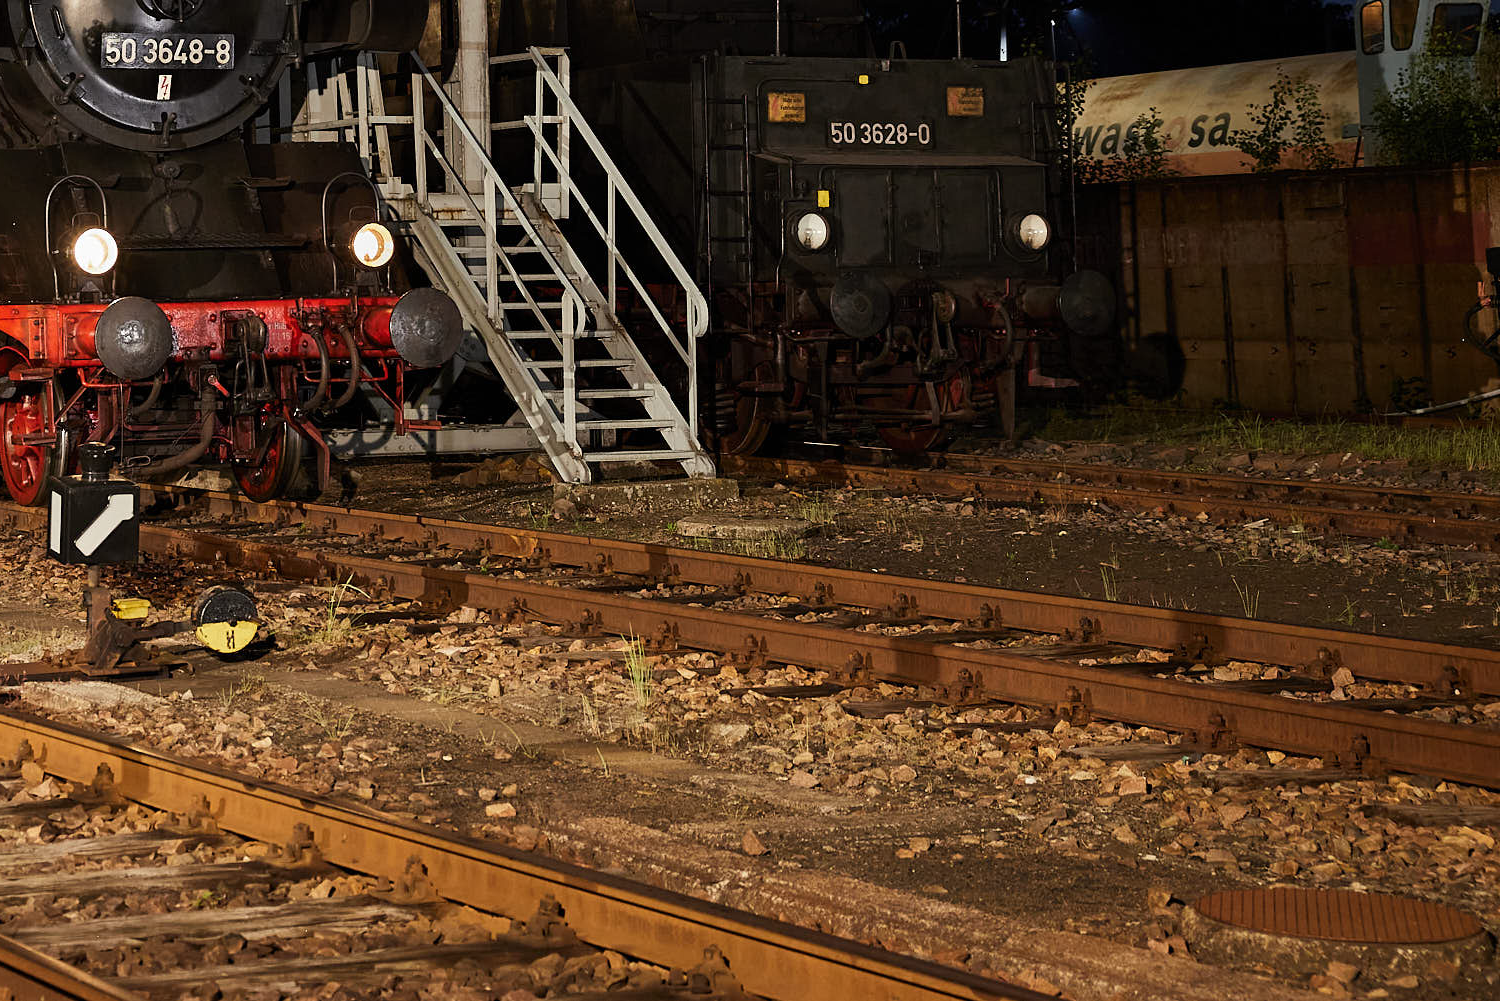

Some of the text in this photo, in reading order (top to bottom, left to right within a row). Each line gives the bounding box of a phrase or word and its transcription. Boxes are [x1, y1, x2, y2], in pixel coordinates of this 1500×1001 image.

[105, 37, 231, 65] 50 3648-8
[830, 121, 931, 146] 50 3628-0
[1072, 111, 1232, 156] wasosa
